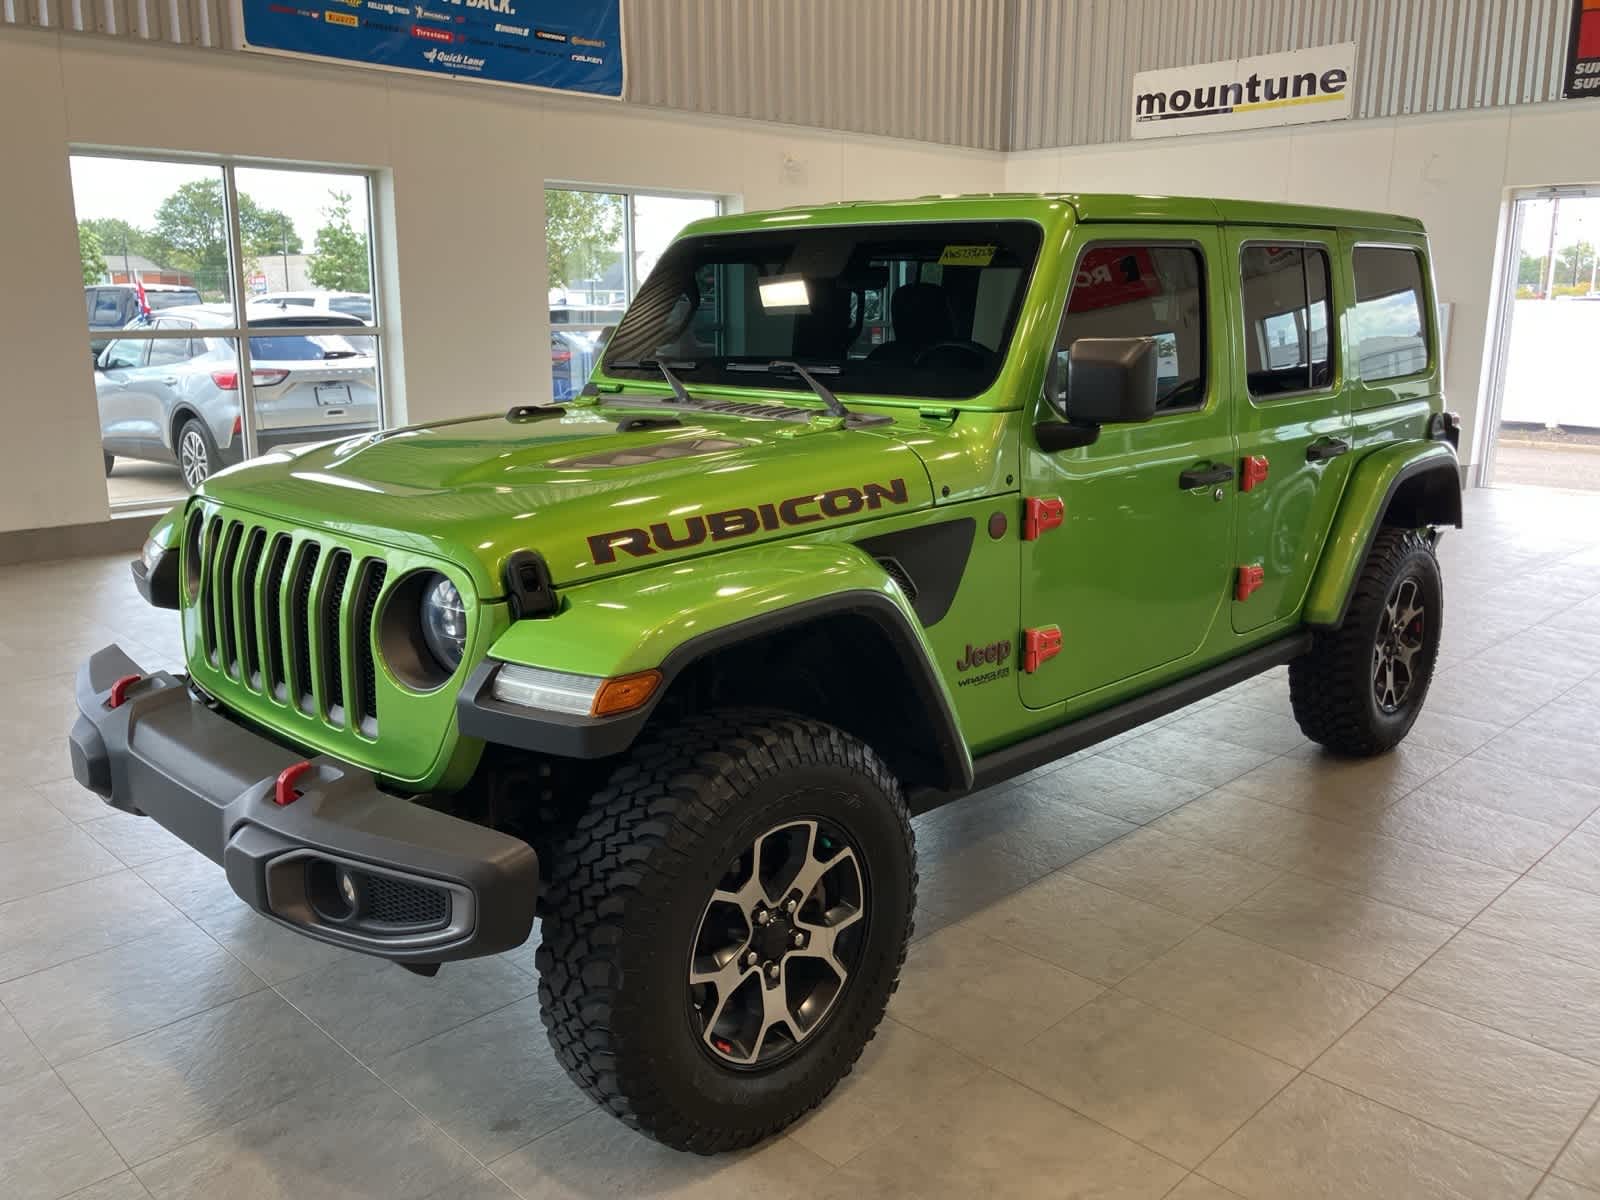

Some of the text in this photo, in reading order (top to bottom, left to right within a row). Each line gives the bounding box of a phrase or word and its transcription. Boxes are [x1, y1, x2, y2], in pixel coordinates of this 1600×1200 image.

[415, 26, 449, 40] Firestone
[437, 51, 486, 66] Quick Lane
[1136, 69, 1347, 115] mountune
[587, 478, 908, 565] RUBICON
[957, 640, 1010, 672] Jeep
